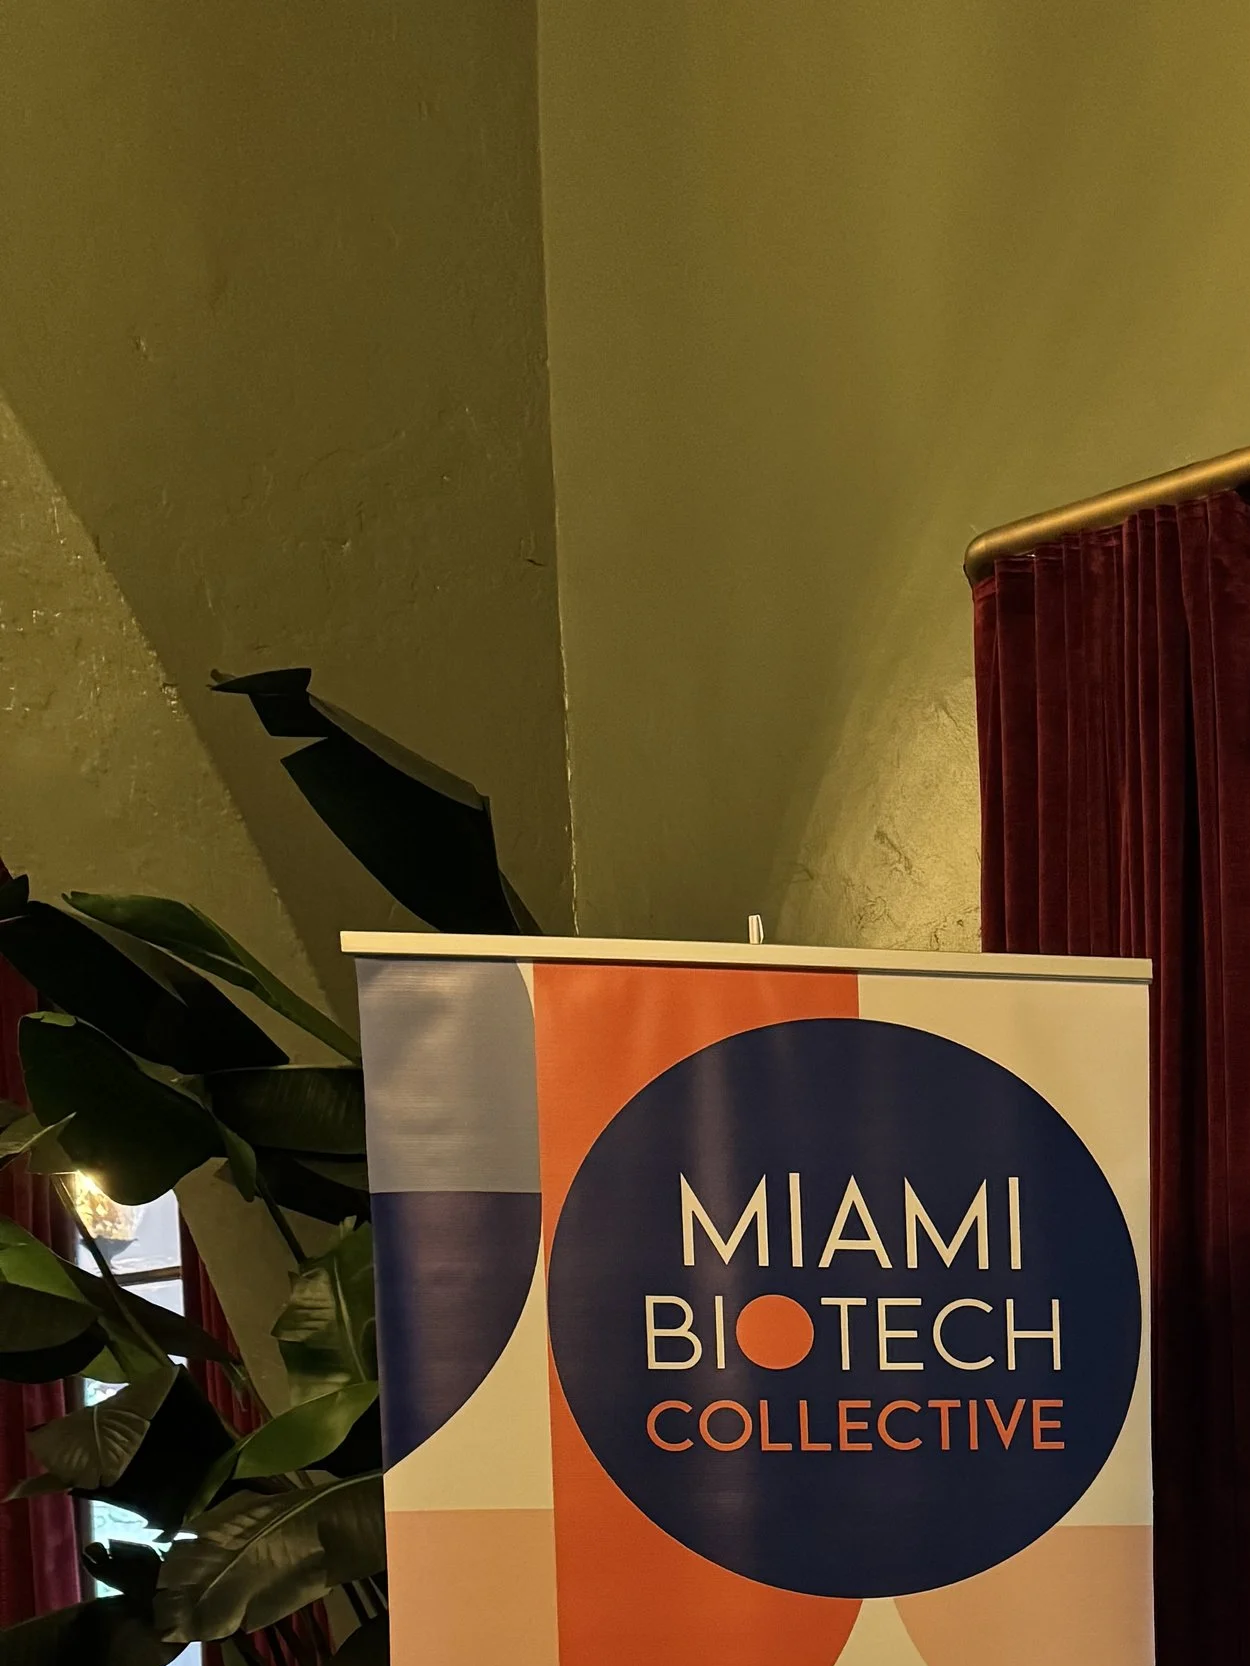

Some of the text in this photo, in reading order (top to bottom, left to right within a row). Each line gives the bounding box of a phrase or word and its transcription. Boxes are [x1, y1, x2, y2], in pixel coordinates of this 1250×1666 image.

[679, 1172, 1022, 1270] MIAMI
[645, 1294, 1063, 1371] BIOTECH
[646, 1399, 1066, 1452] COLLECTIVE
